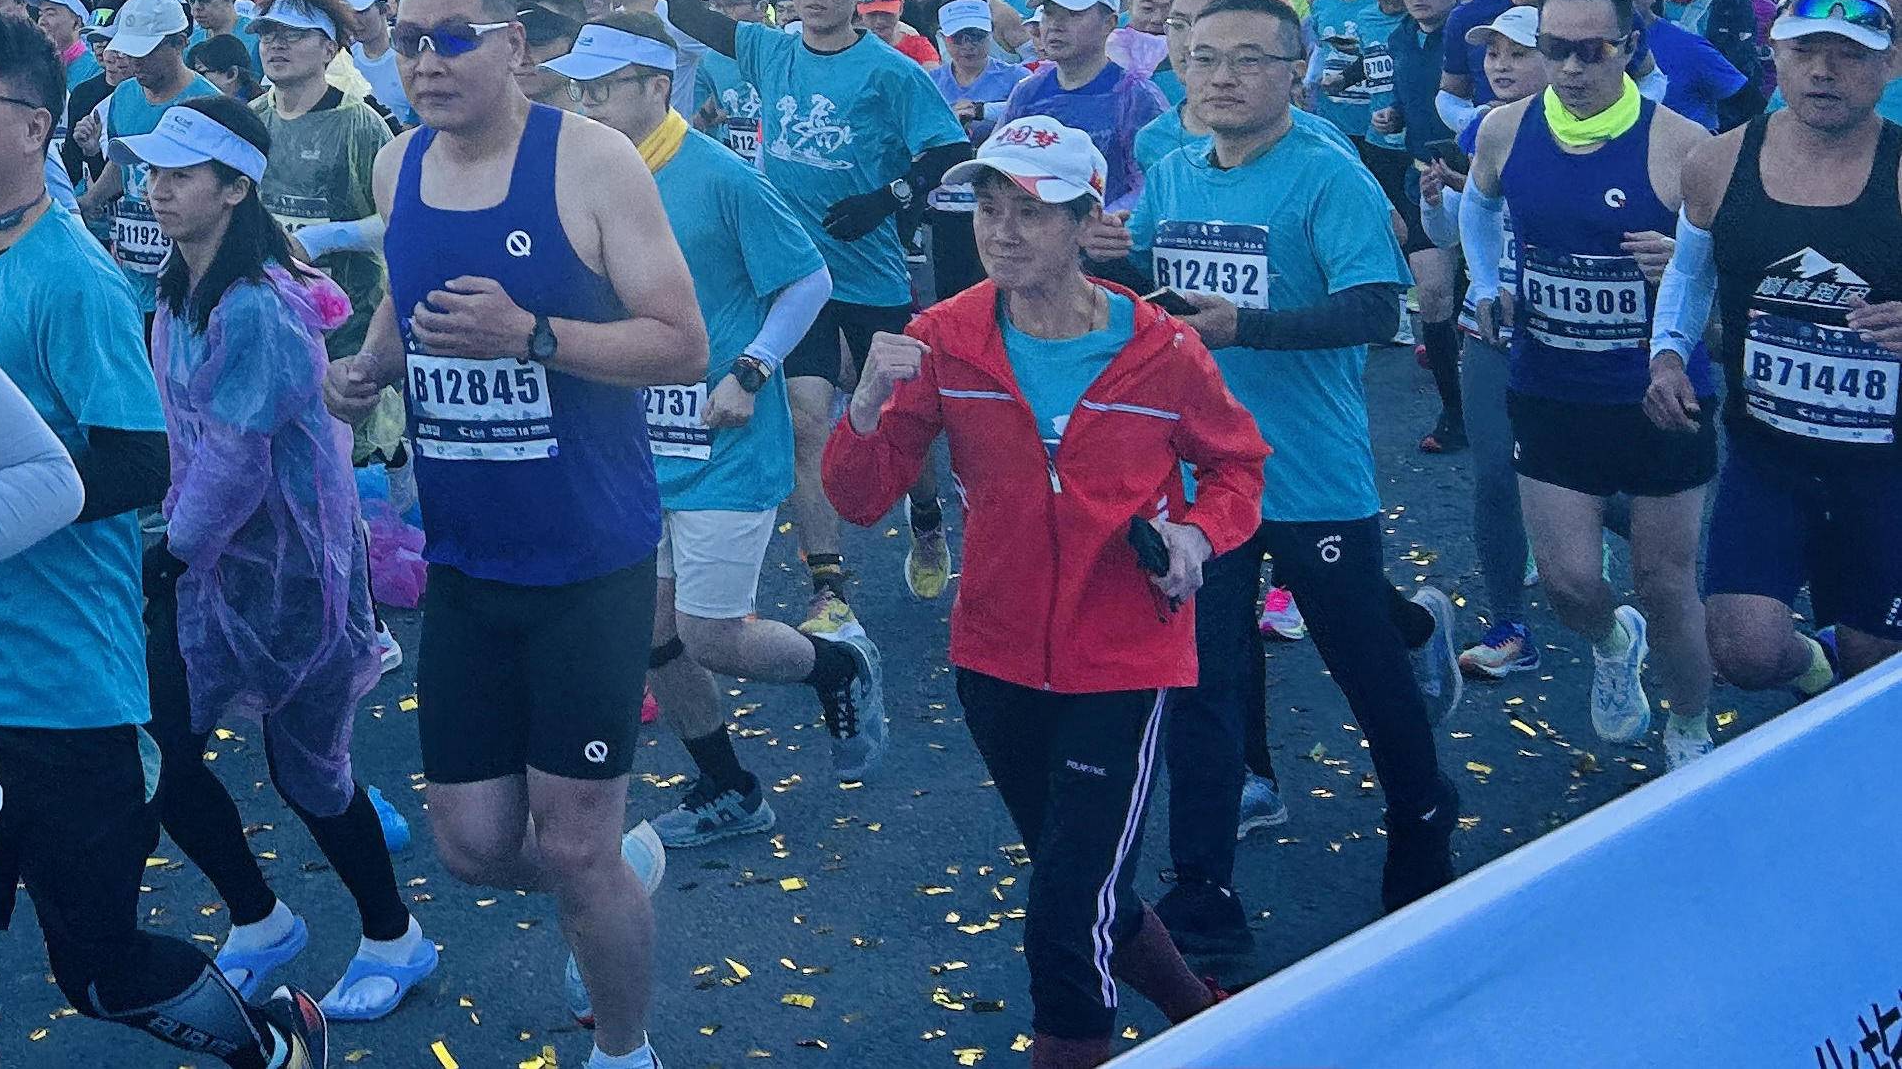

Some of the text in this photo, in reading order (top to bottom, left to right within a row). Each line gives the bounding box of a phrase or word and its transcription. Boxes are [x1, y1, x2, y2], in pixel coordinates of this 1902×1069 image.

[1157, 256, 1259, 296] B12432
[1528, 277, 1637, 315] B11308
[413, 366, 539, 406] B12845
[1752, 350, 1887, 401] B71448
